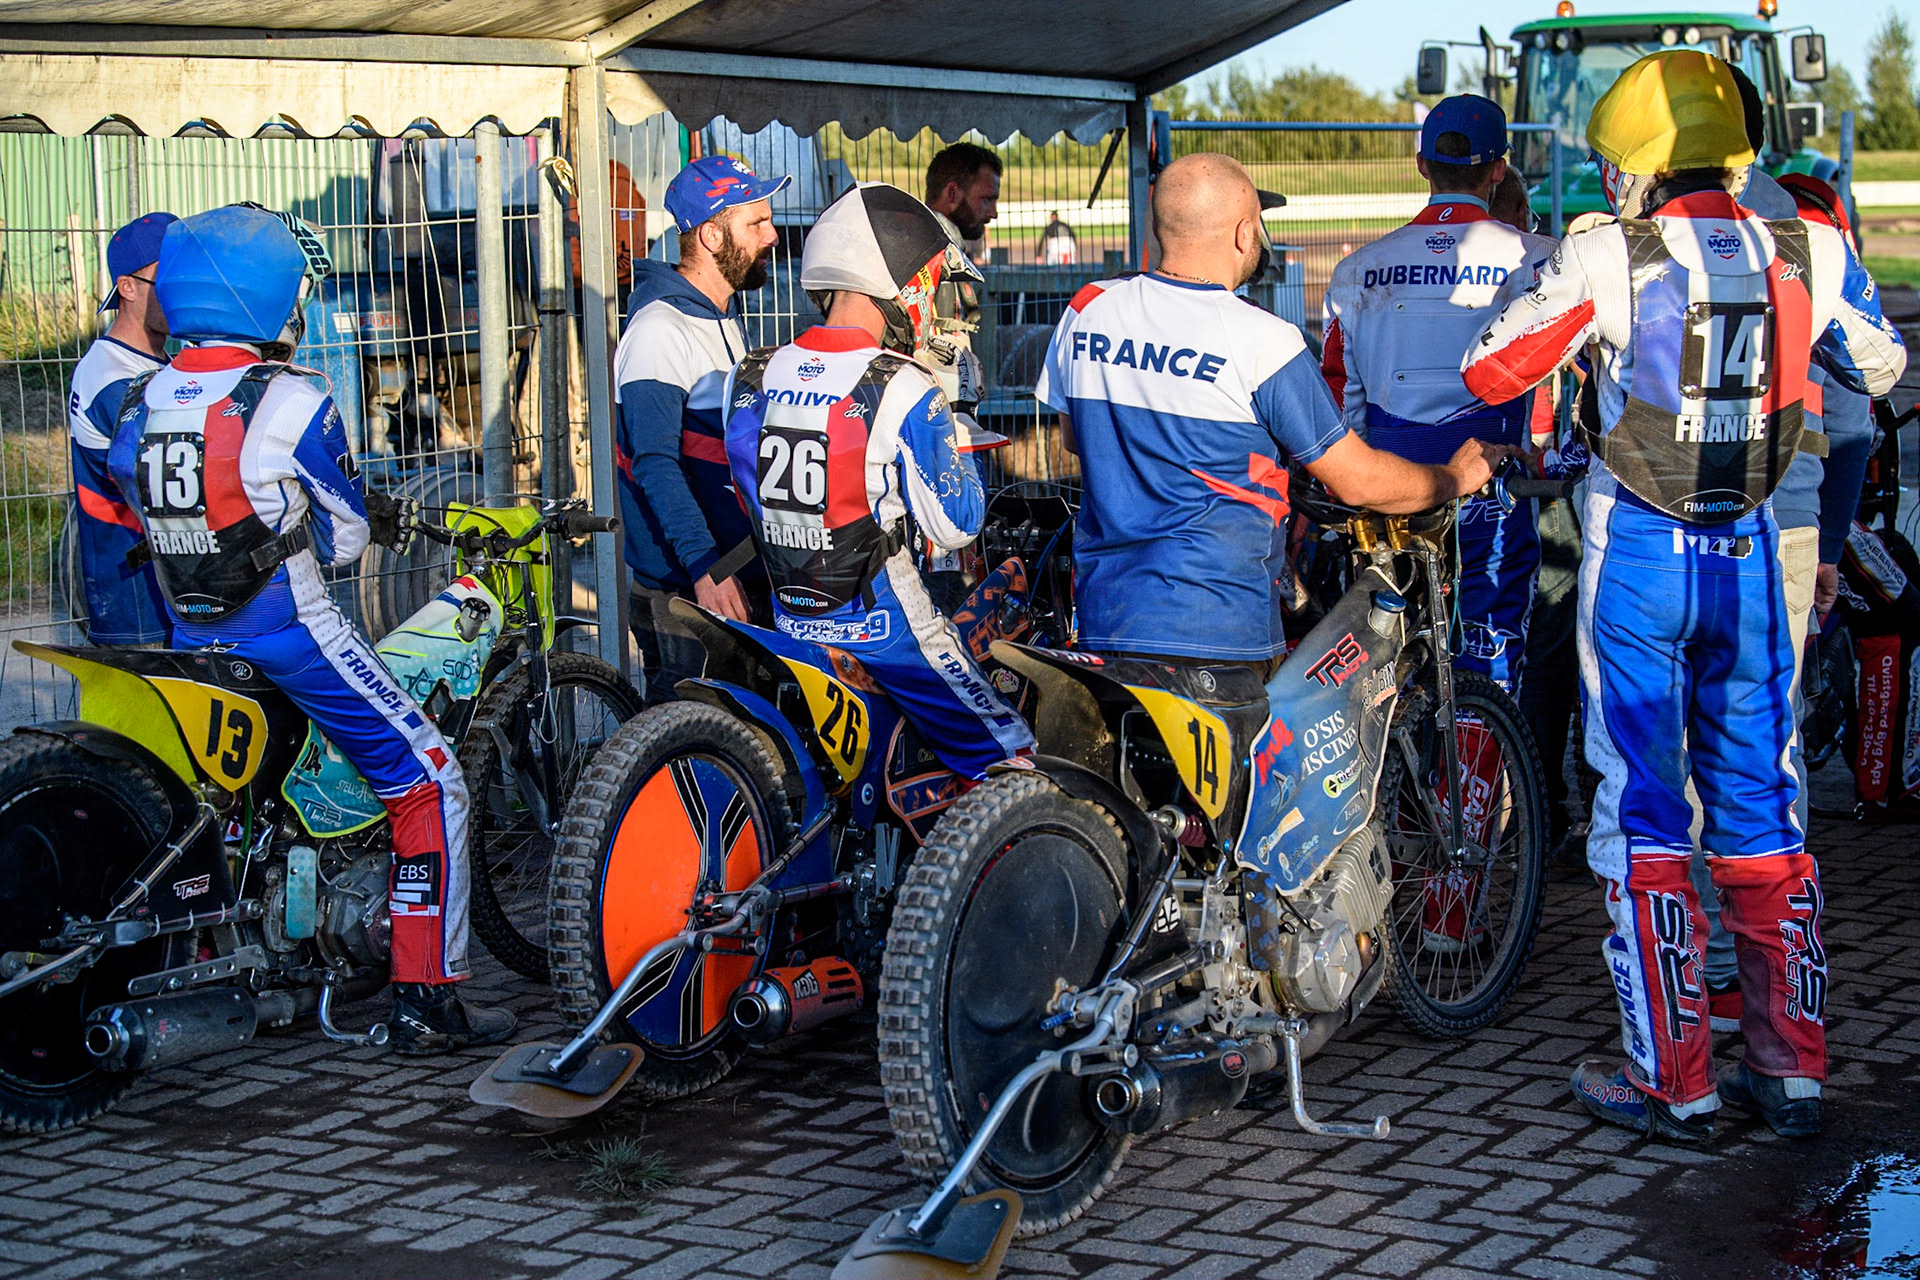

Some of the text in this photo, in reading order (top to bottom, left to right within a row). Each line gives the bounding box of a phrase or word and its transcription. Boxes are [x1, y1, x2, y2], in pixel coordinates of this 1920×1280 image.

[1426, 238, 1456, 246] MOTO
[1707, 238, 1741, 248] MOTO
[1364, 264, 1508, 289] DUBERNARD
[798, 364, 826, 375] MOTO
[1072, 331, 1228, 384] FRANCE
[1691, 314, 1766, 389] 14
[174, 387, 203, 396] MOTO
[1674, 412, 1768, 443] FRANCE
[140, 441, 200, 509] 13
[759, 434, 827, 506] 26
[150, 529, 222, 556] FRANCE
[761, 520, 835, 551] FRANCE
[338, 648, 407, 713] FRANCE
[938, 651, 995, 713] FRANCE
[1304, 631, 1362, 689] TRS
[205, 697, 254, 780] 13
[819, 680, 861, 757] 26
[1870, 655, 1893, 786] Qvistgaard Byg Aps
[1187, 716, 1219, 806] 14
[399, 864, 429, 881] EBS
[1645, 890, 1702, 1042] TRS
[1779, 924, 1801, 1022] RACING
[1785, 877, 1829, 1027] TRS
[1581, 1076, 1640, 1104] dayton
